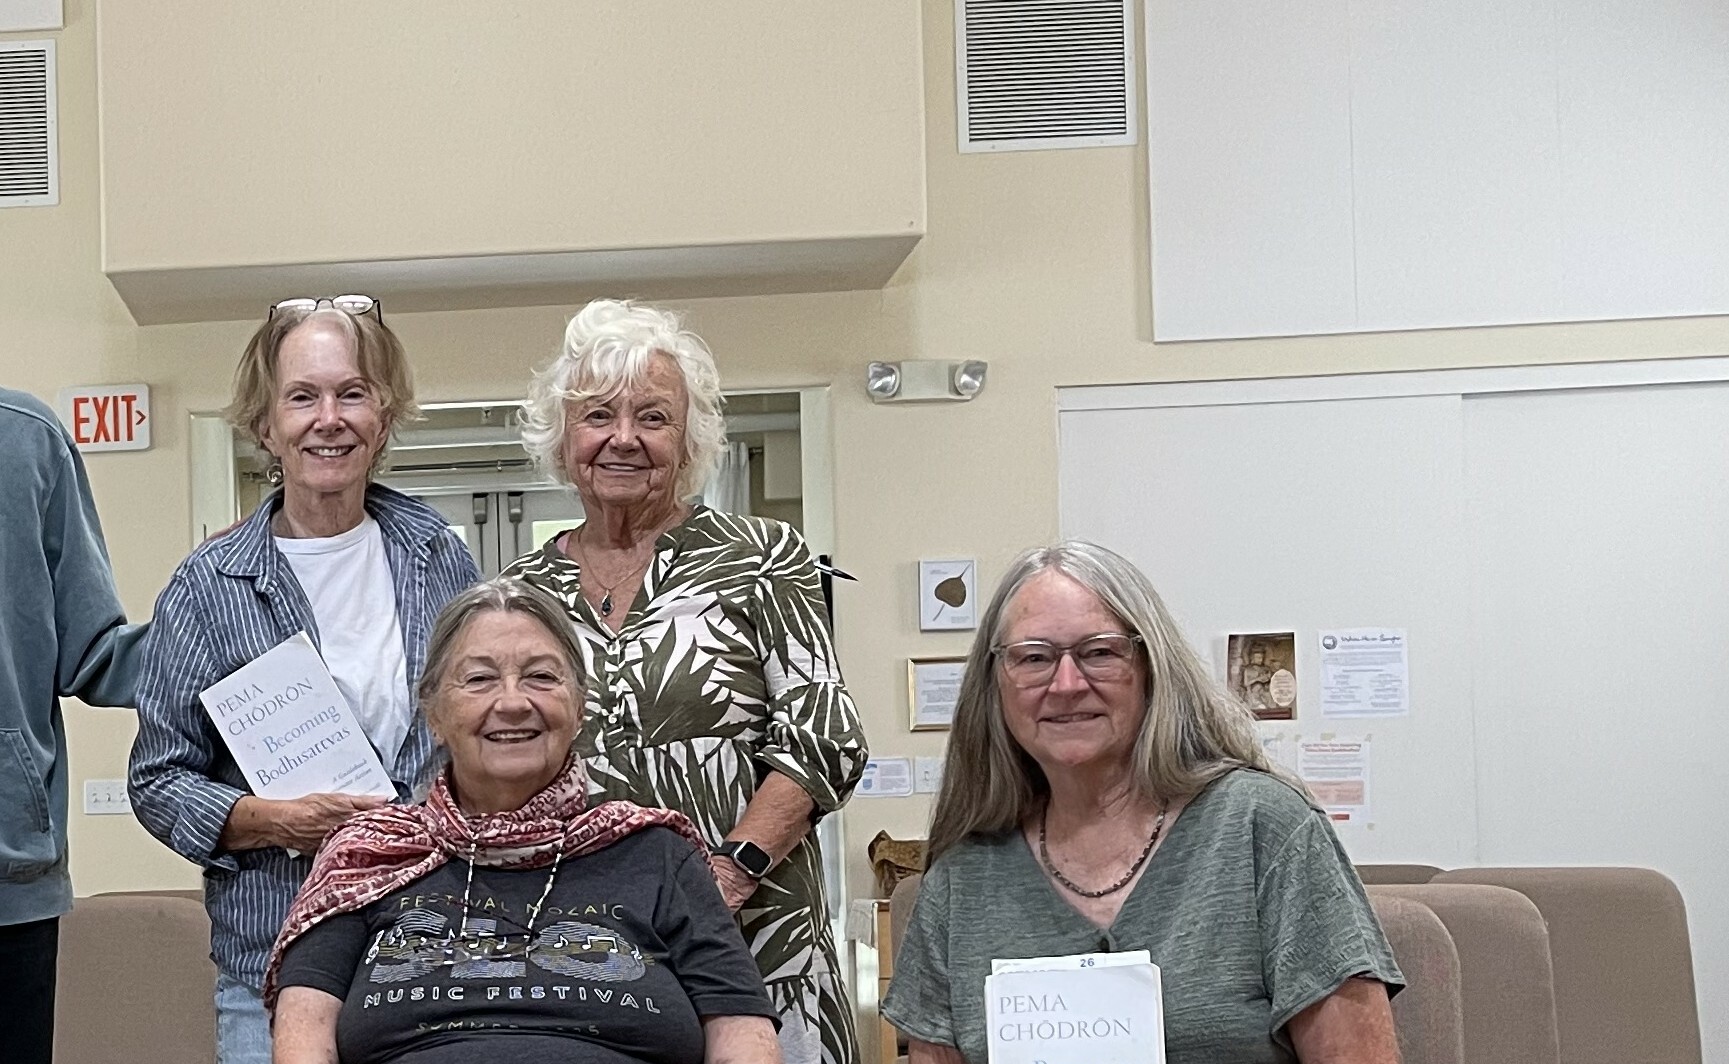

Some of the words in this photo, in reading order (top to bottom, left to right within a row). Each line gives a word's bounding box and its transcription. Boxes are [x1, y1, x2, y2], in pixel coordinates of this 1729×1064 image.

[73, 395, 137, 443] EXIT
[216, 683, 264, 717] PEMA
[262, 705, 341, 755] Becoming
[255, 725, 351, 788] Bodhisattvas
[1079, 957, 1095, 968] 26
[363, 986, 464, 1009] MUSIC
[487, 986, 663, 1014] FESTIVAL
[999, 994, 1068, 1014] PEMA
